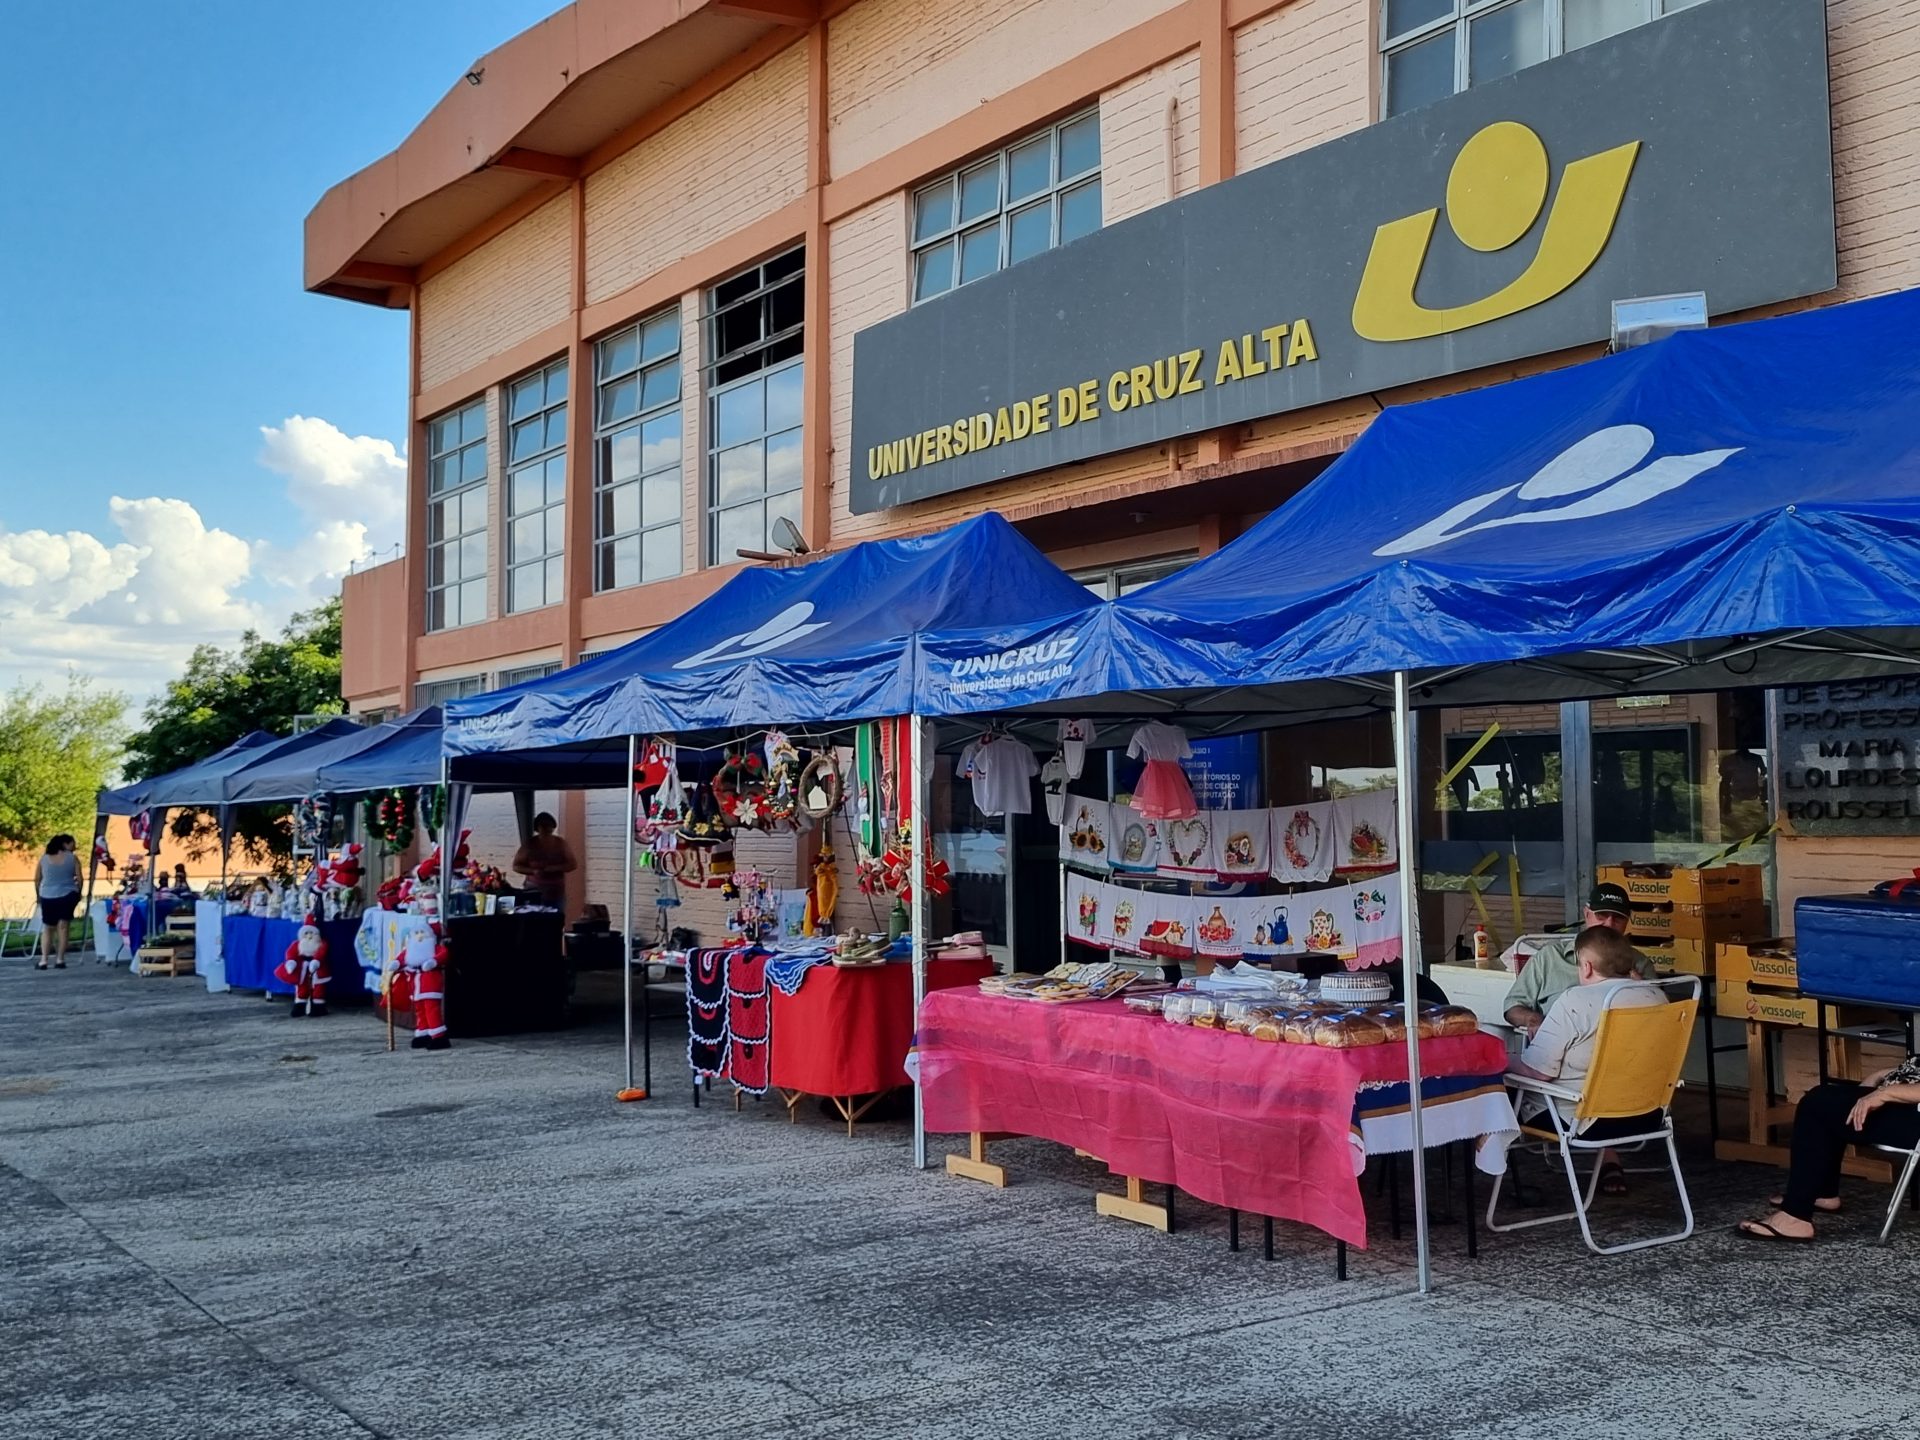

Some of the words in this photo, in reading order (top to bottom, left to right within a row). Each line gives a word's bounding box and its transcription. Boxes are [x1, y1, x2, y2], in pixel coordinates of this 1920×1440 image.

[868, 393, 1051, 481] UNIVERSIDADE
[1057, 378, 1100, 428] DE
[1107, 348, 1204, 413] CRUZ
[1214, 318, 1318, 386] ALTA
[951, 637, 1079, 677] UNICRUZ
[950, 671, 1011, 695] Universidade
[1012, 672, 1025, 686] de
[1026, 668, 1050, 684] Cruz
[1051, 663, 1072, 680] Alta
[1782, 707, 1920, 731] PROFESS
[1818, 738, 1908, 758] MARIA
[1627, 880, 1670, 895] Vassoler
[1630, 913, 1671, 928] Vassoler
[1750, 958, 1796, 977] Vassole
[1760, 1003, 1807, 1021] vassoler
